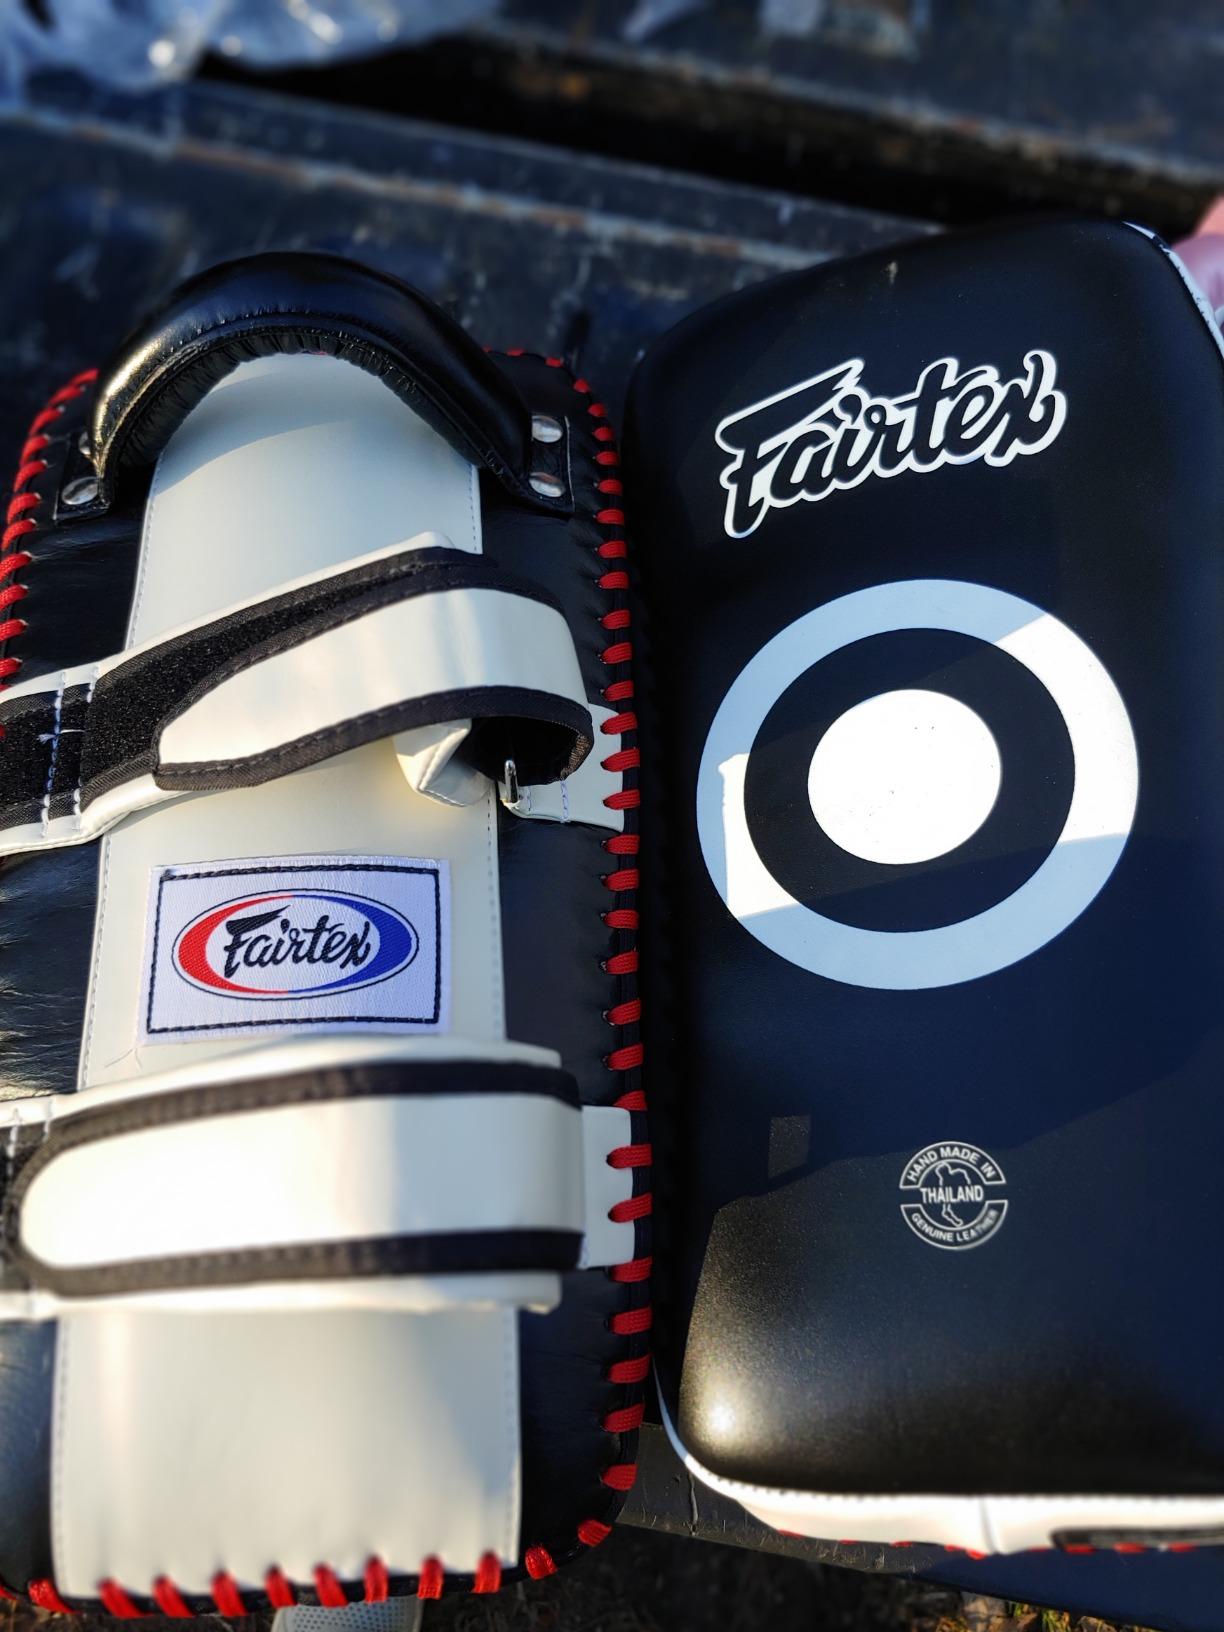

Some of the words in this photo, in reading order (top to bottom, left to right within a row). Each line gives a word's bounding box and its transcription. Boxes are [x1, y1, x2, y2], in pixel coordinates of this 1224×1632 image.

[715, 350, 1066, 538] Fairtex
[224, 904, 370, 979] Fairtex
[907, 1150, 938, 1182] HAND
[940, 1146, 980, 1164] MADE
[980, 1162, 996, 1179] IN
[920, 1185, 984, 1203] THAILAND
[911, 1213, 954, 1241] GENUINE
